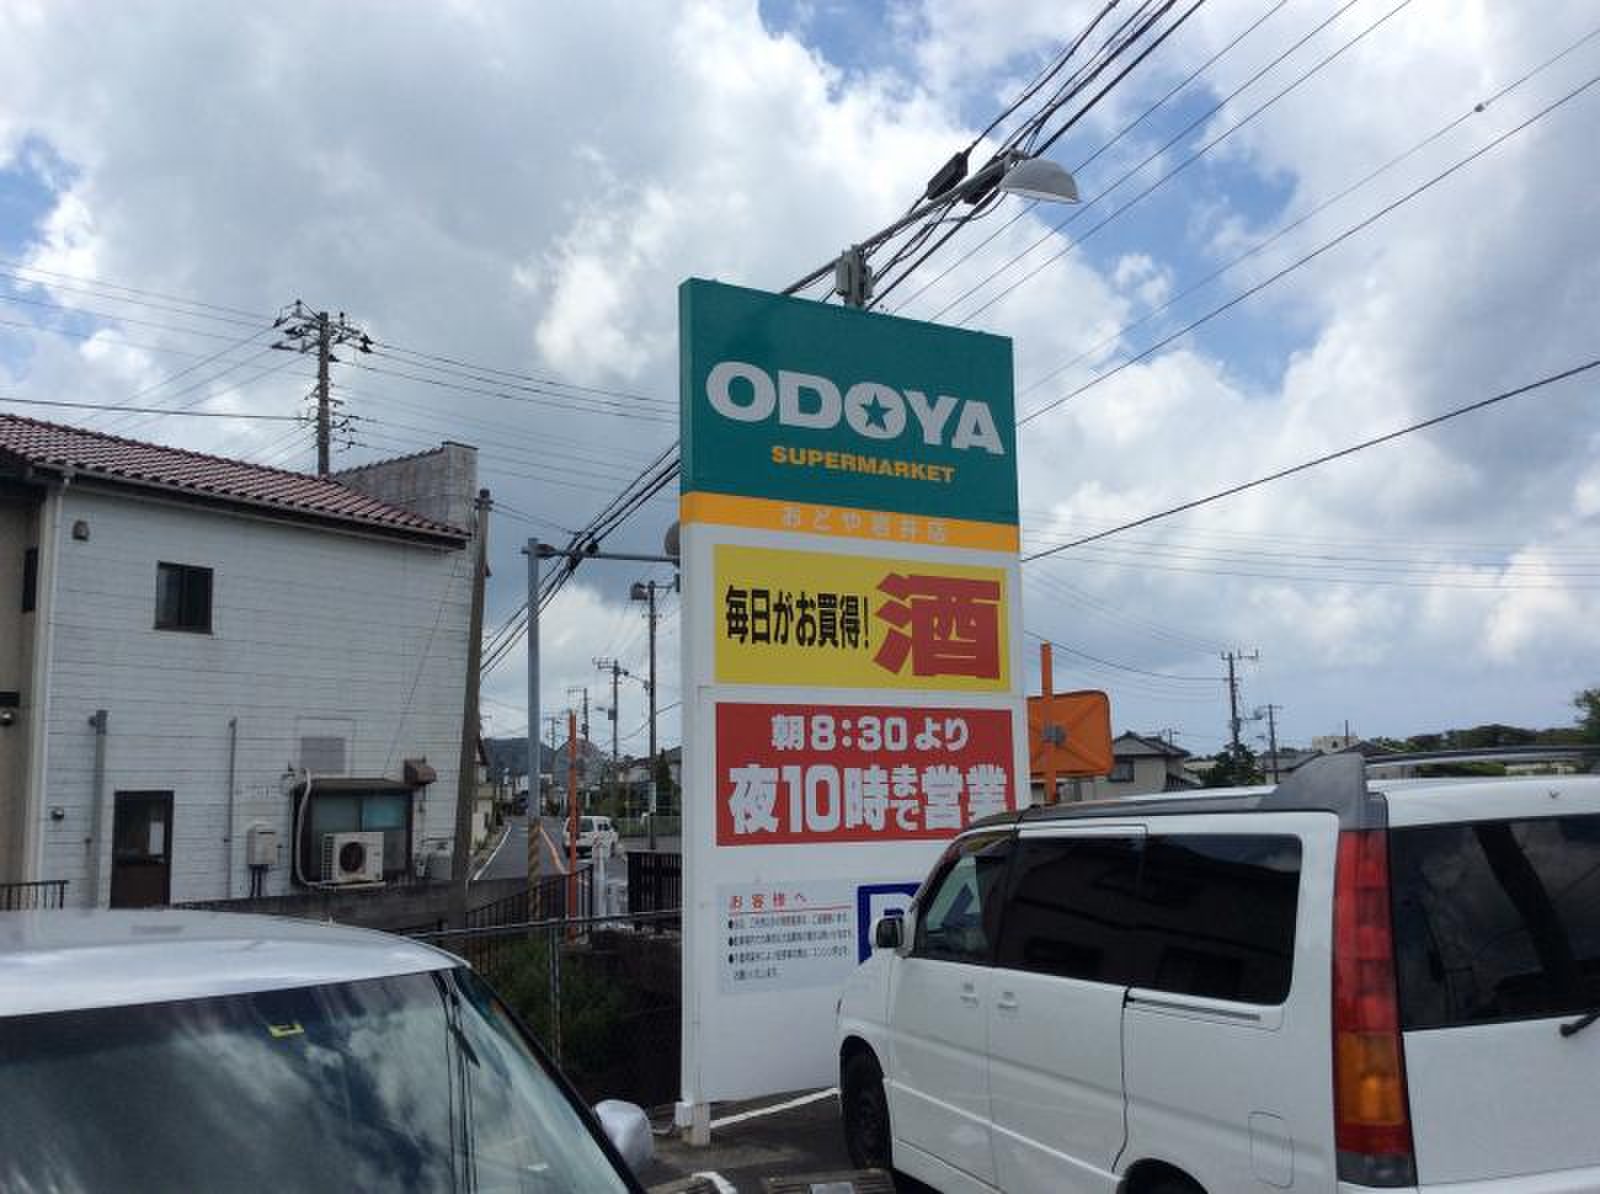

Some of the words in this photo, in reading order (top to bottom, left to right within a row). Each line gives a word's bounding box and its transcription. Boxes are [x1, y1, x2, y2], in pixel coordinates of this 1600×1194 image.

[705, 361, 1004, 455] ODOYA
[772, 446, 955, 483] SUPERMARKET
[872, 572, 1000, 680] 酒
[771, 714, 969, 751] 朝8:30より
